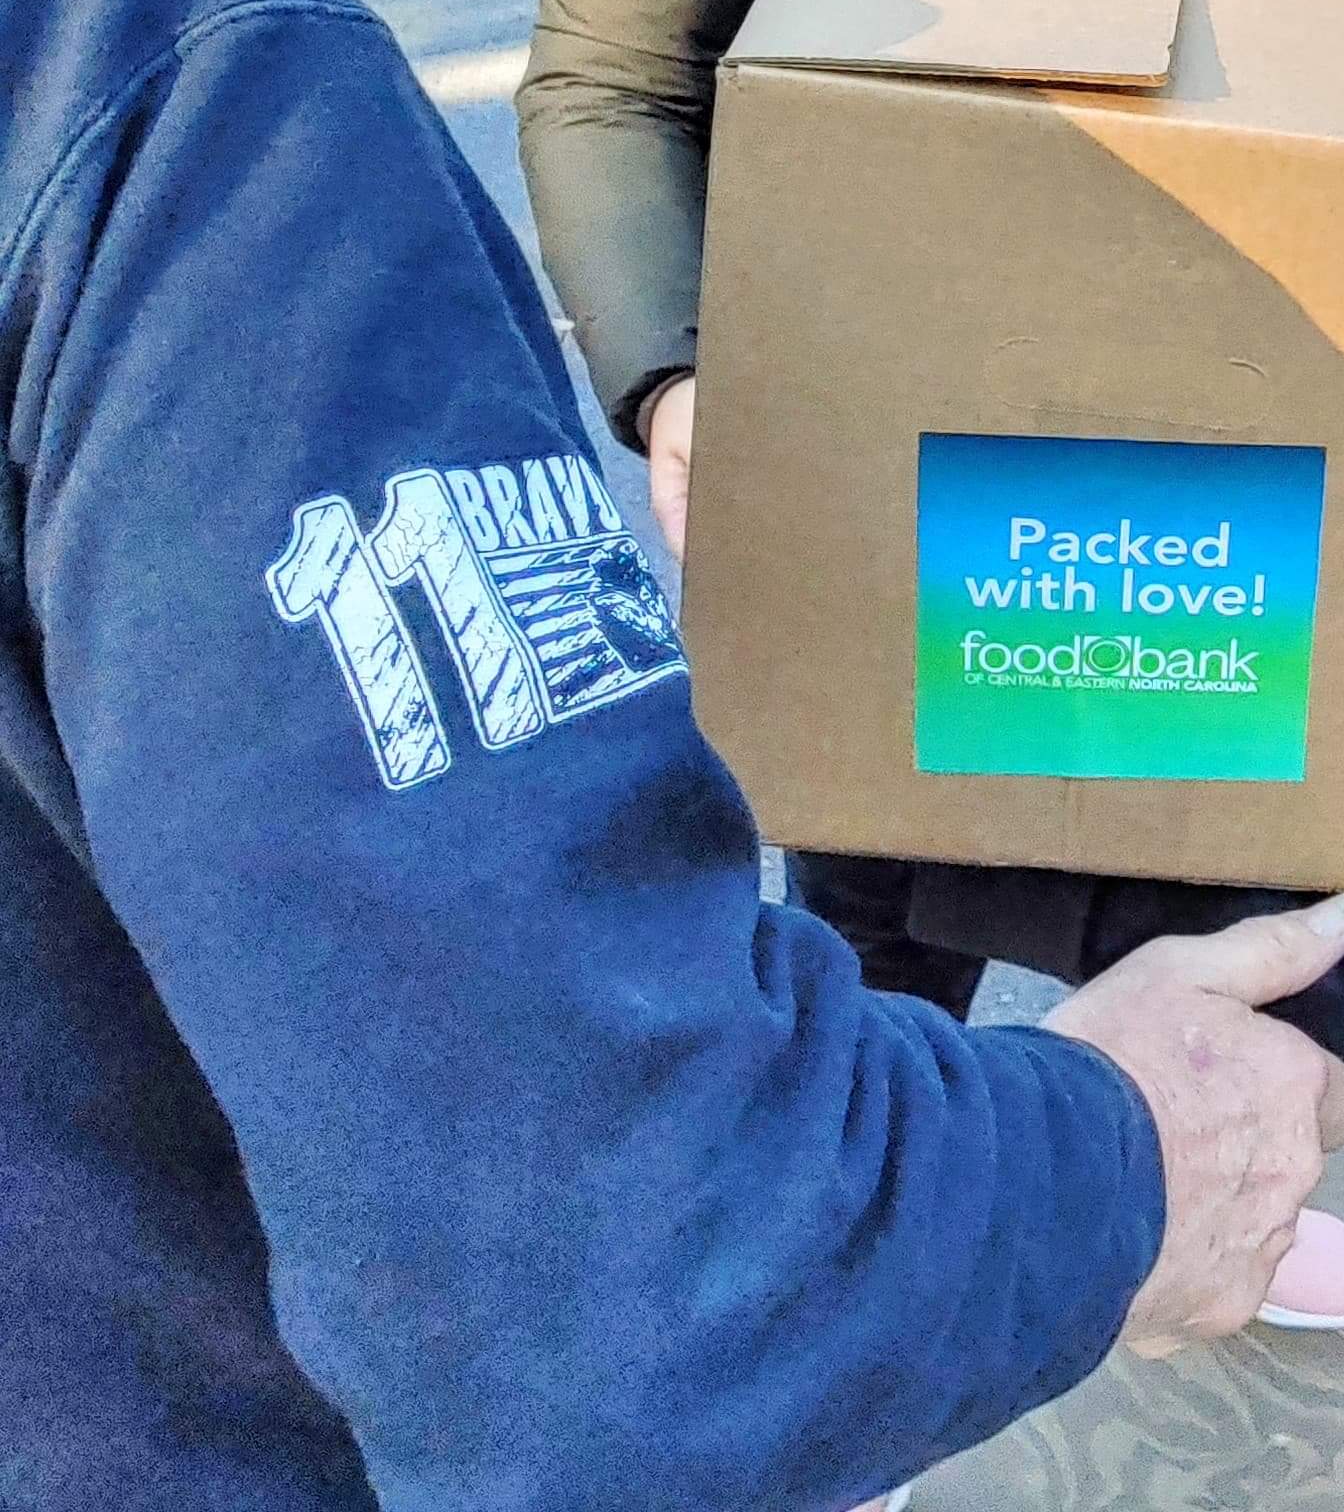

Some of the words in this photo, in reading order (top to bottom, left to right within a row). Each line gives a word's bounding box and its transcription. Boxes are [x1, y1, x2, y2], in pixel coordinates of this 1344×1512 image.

[1008, 516, 1232, 568] Packed
[964, 566, 1097, 613] with
[1121, 567, 1267, 617] love!
[964, 672, 985, 686] OF
[987, 673, 1051, 688] CENTRAL
[1052, 674, 1062, 688] &
[1065, 675, 1125, 690] EASTERN
[1128, 677, 1181, 691] NORTH
[1183, 679, 1258, 694] CAROLINA
